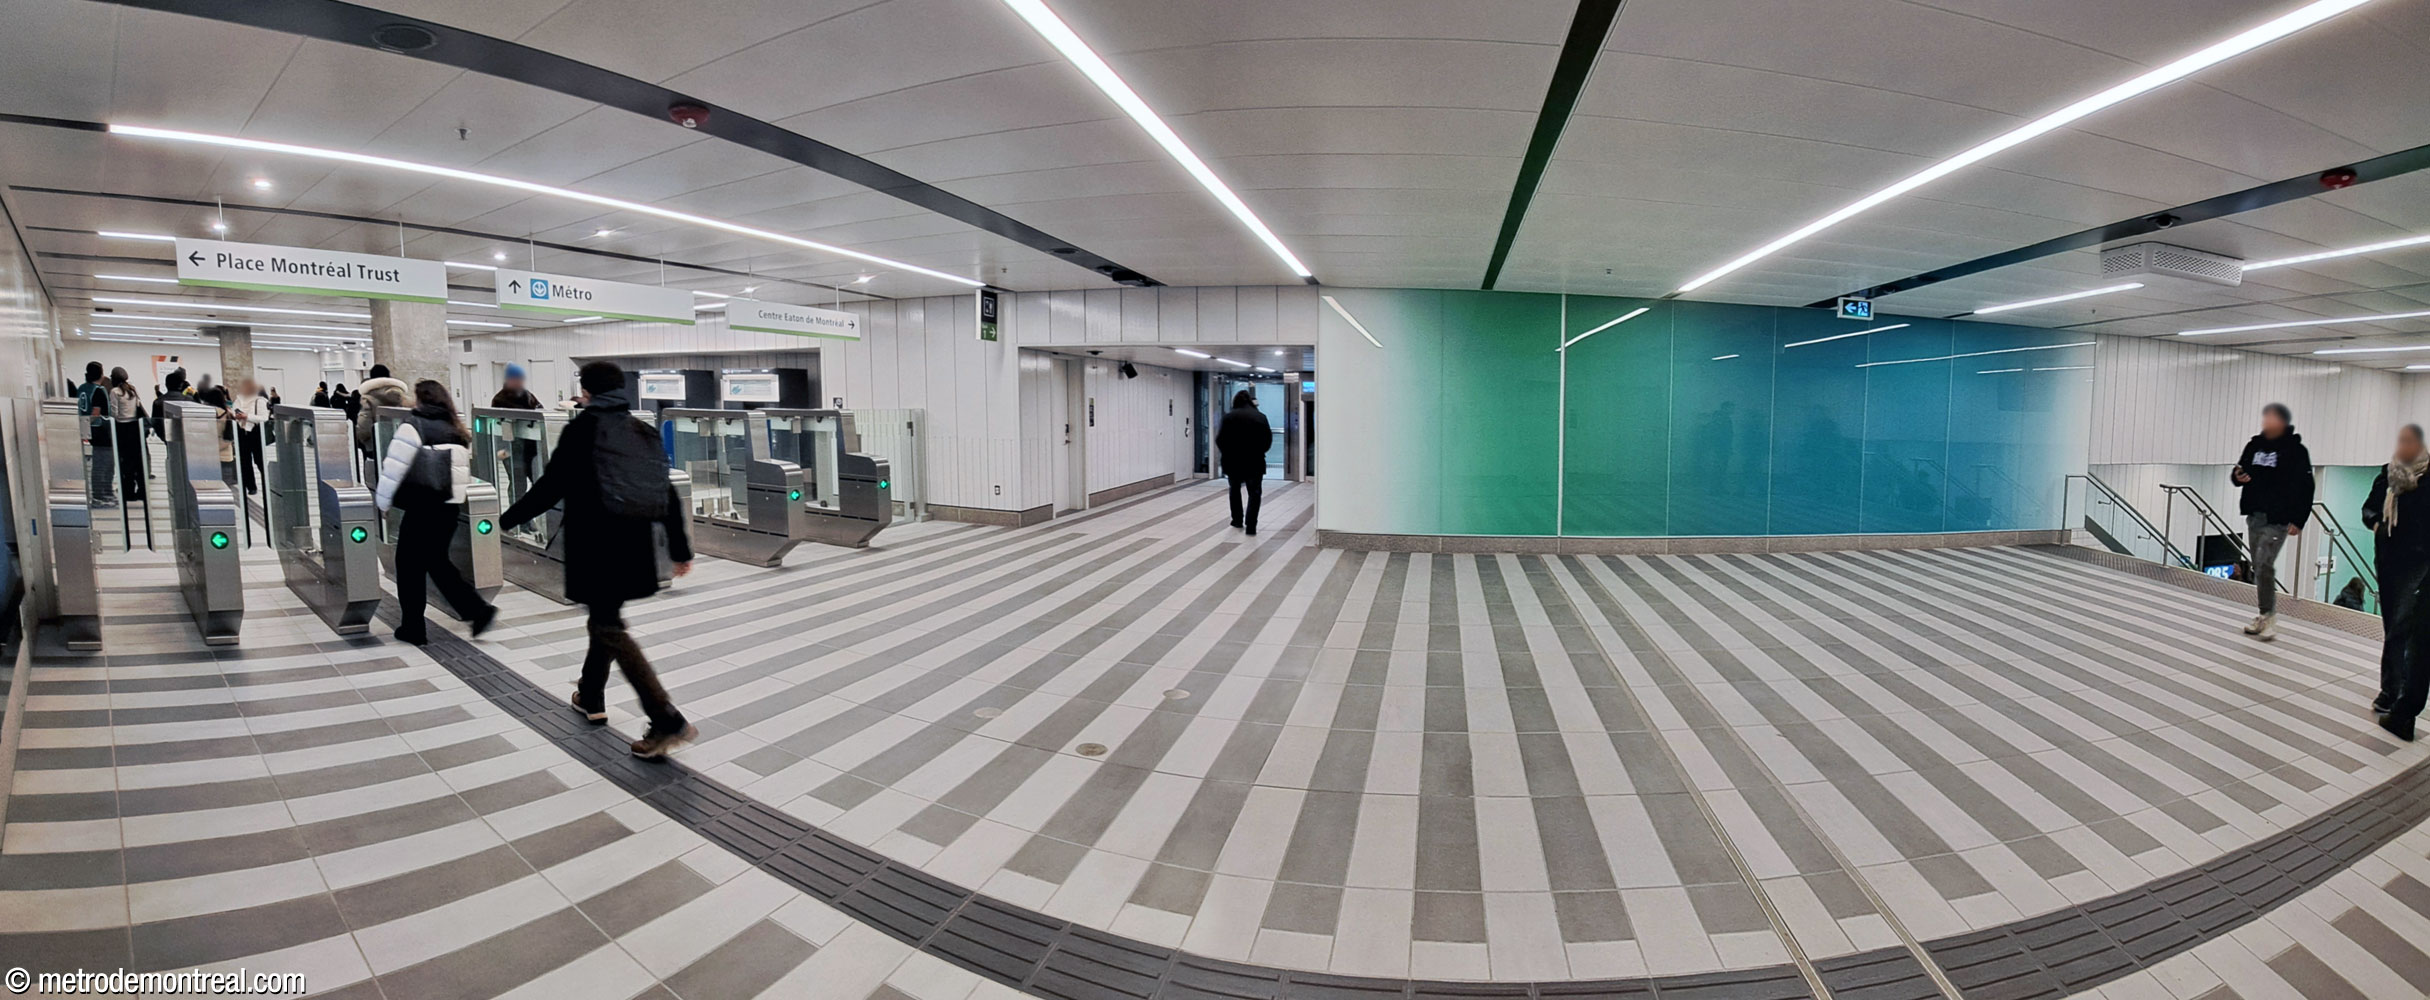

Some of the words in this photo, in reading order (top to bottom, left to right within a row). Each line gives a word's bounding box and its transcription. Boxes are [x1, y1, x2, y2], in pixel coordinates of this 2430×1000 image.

[216, 253, 264, 272] Place
[271, 257, 351, 278] Montréal
[357, 264, 400, 282] Trust
[552, 284, 592, 301] Métro
[758, 310, 783, 321] Centre
[784, 313, 804, 322] Eaton
[805, 315, 815, 323] de
